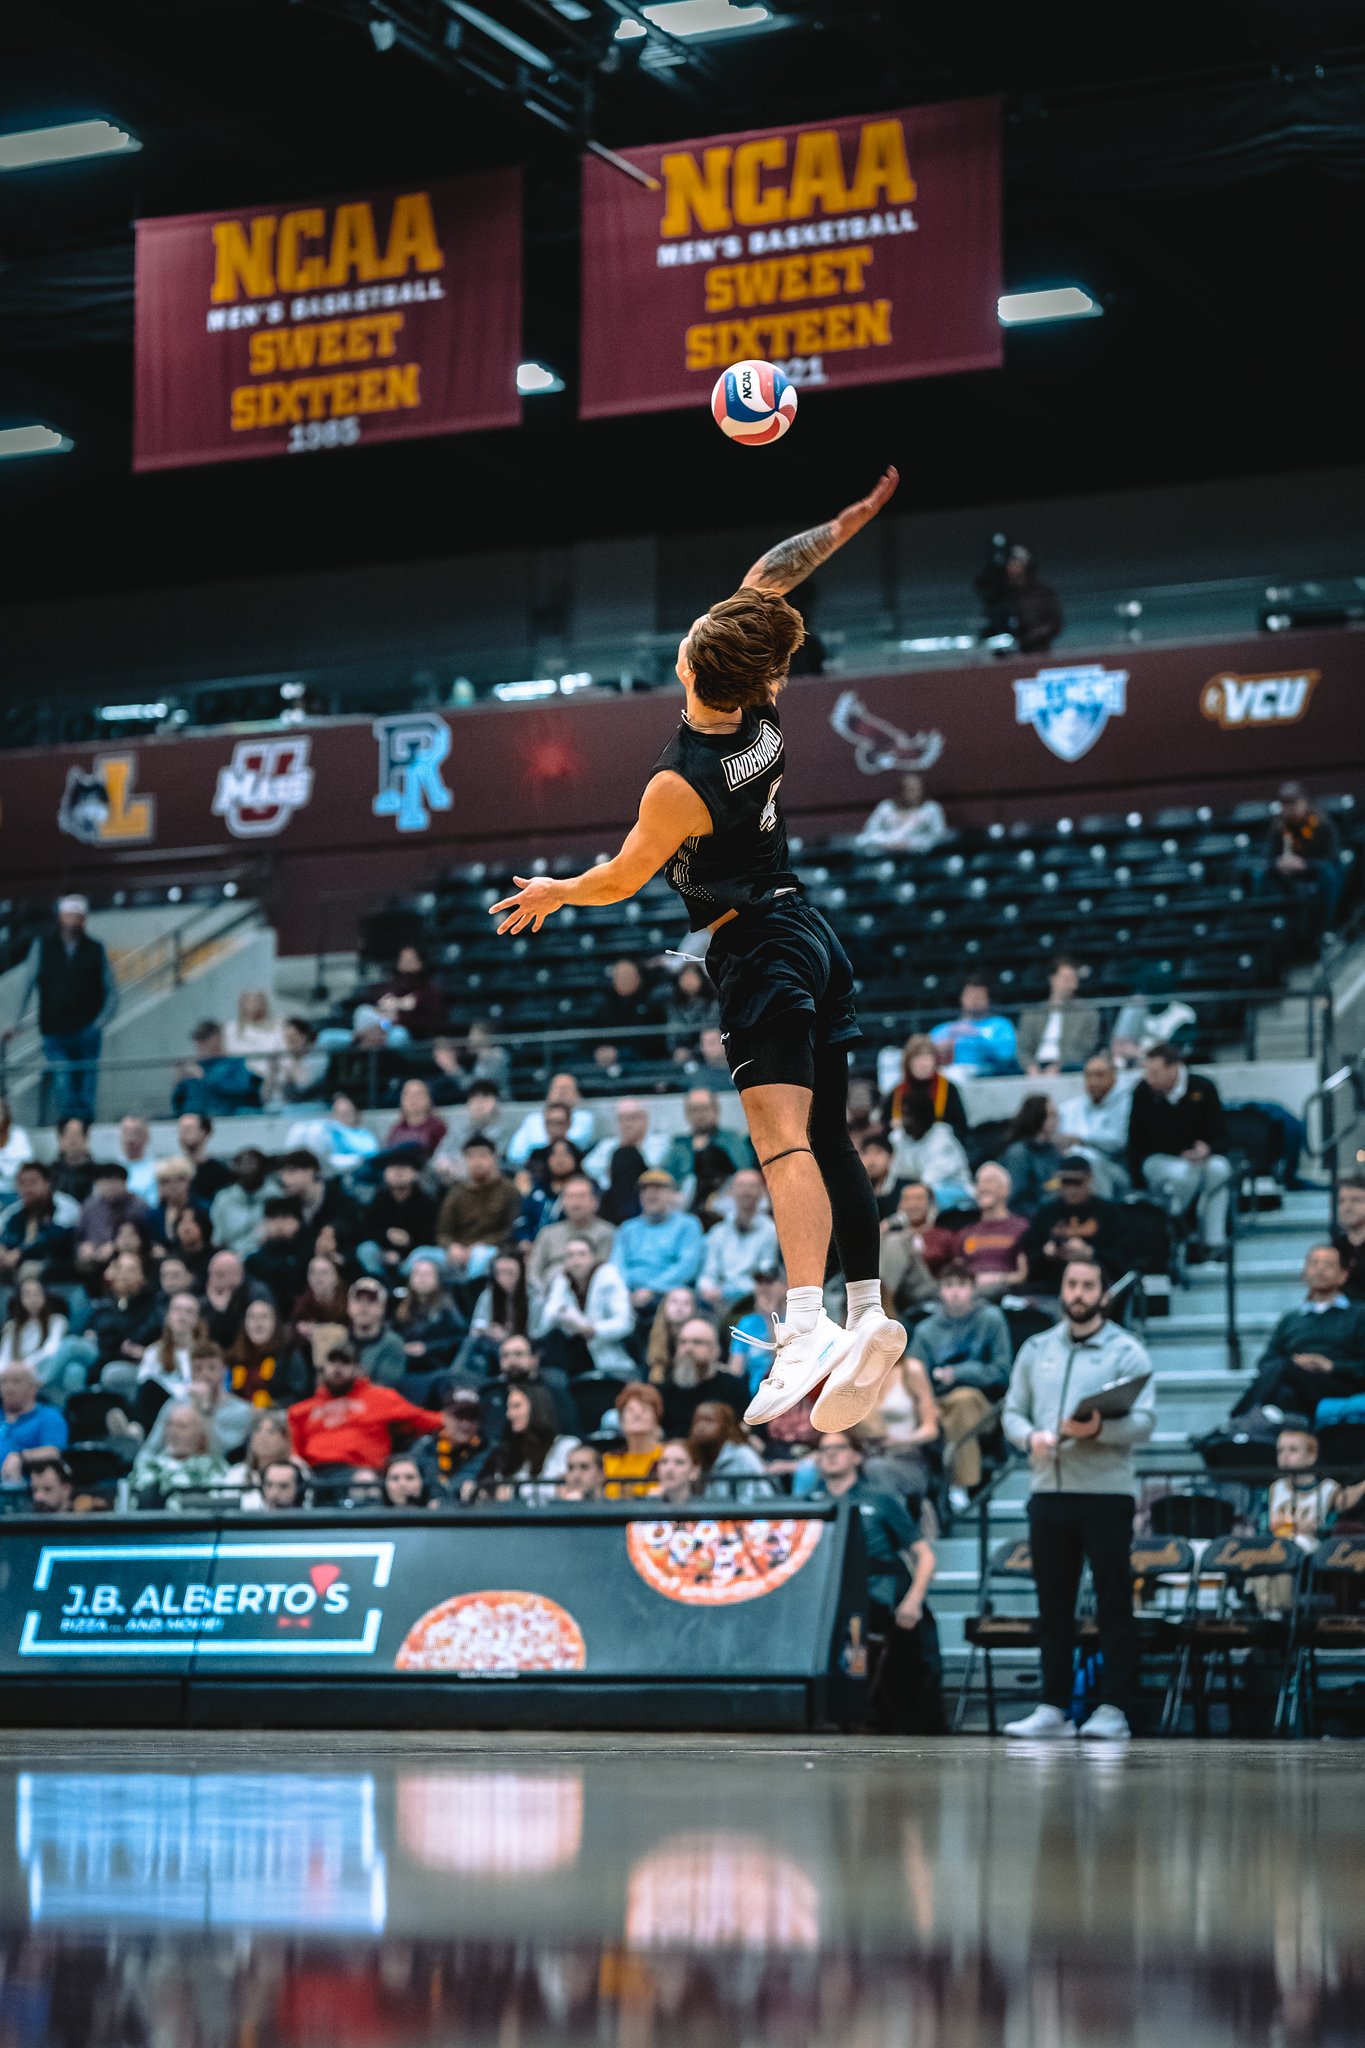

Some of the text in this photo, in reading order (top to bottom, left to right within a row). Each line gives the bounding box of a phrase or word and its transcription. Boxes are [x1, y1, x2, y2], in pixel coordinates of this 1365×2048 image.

[660, 119, 916, 238] NCAA
[210, 192, 444, 304] NCAA
[656, 209, 918, 268] MEN'S BASKETBALL
[207, 278, 445, 332] MEN'S BASKETBALL
[705, 246, 873, 313] SWEET
[249, 312, 403, 375] SWEET
[685, 299, 893, 371] SIXTEEN
[230, 363, 421, 431] SIXTEEN
[743, 371, 752, 399] NCAA
[1222, 677, 1309, 722] VCU
[61, 1584, 126, 1616] J.B.
